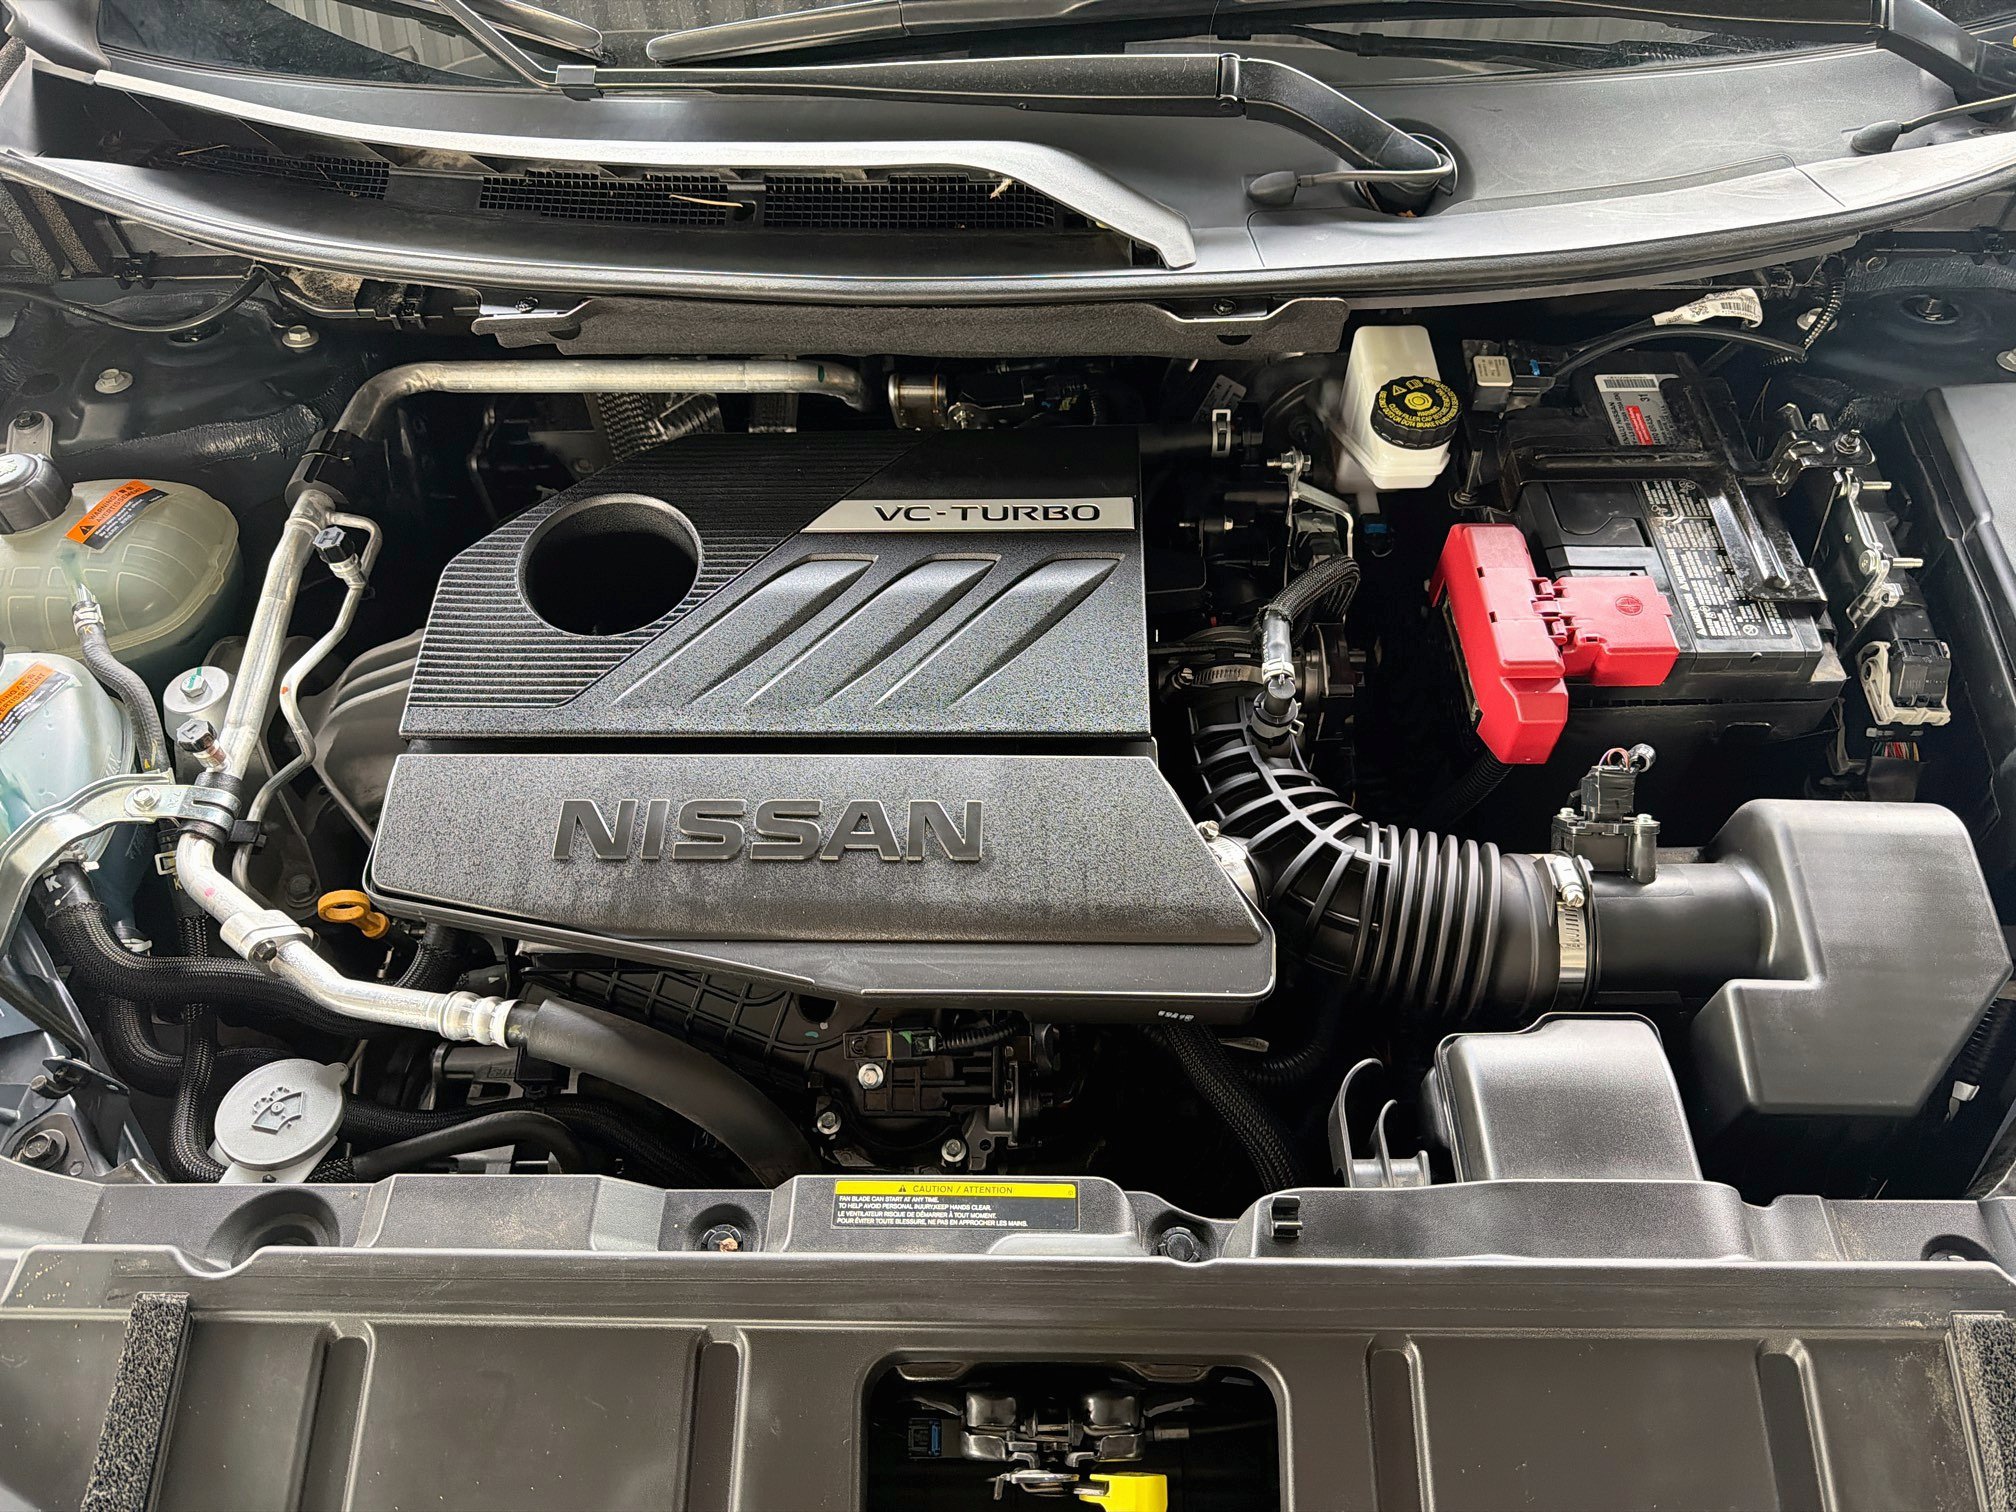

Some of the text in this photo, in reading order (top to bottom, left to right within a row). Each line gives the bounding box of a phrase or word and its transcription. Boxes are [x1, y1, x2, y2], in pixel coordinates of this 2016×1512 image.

[89, 495, 117, 520] WARNING
[97, 487, 144, 523] AVERTISSEMENT
[873, 504, 1101, 522] VC-TURBO
[552, 799, 983, 862] NISSAN
[44, 875, 61, 892] K
[913, 1185, 953, 1193] CAUTION
[963, 1186, 1013, 1194] ATTENTION
[916, 1210, 948, 1218] DÉMARRER
